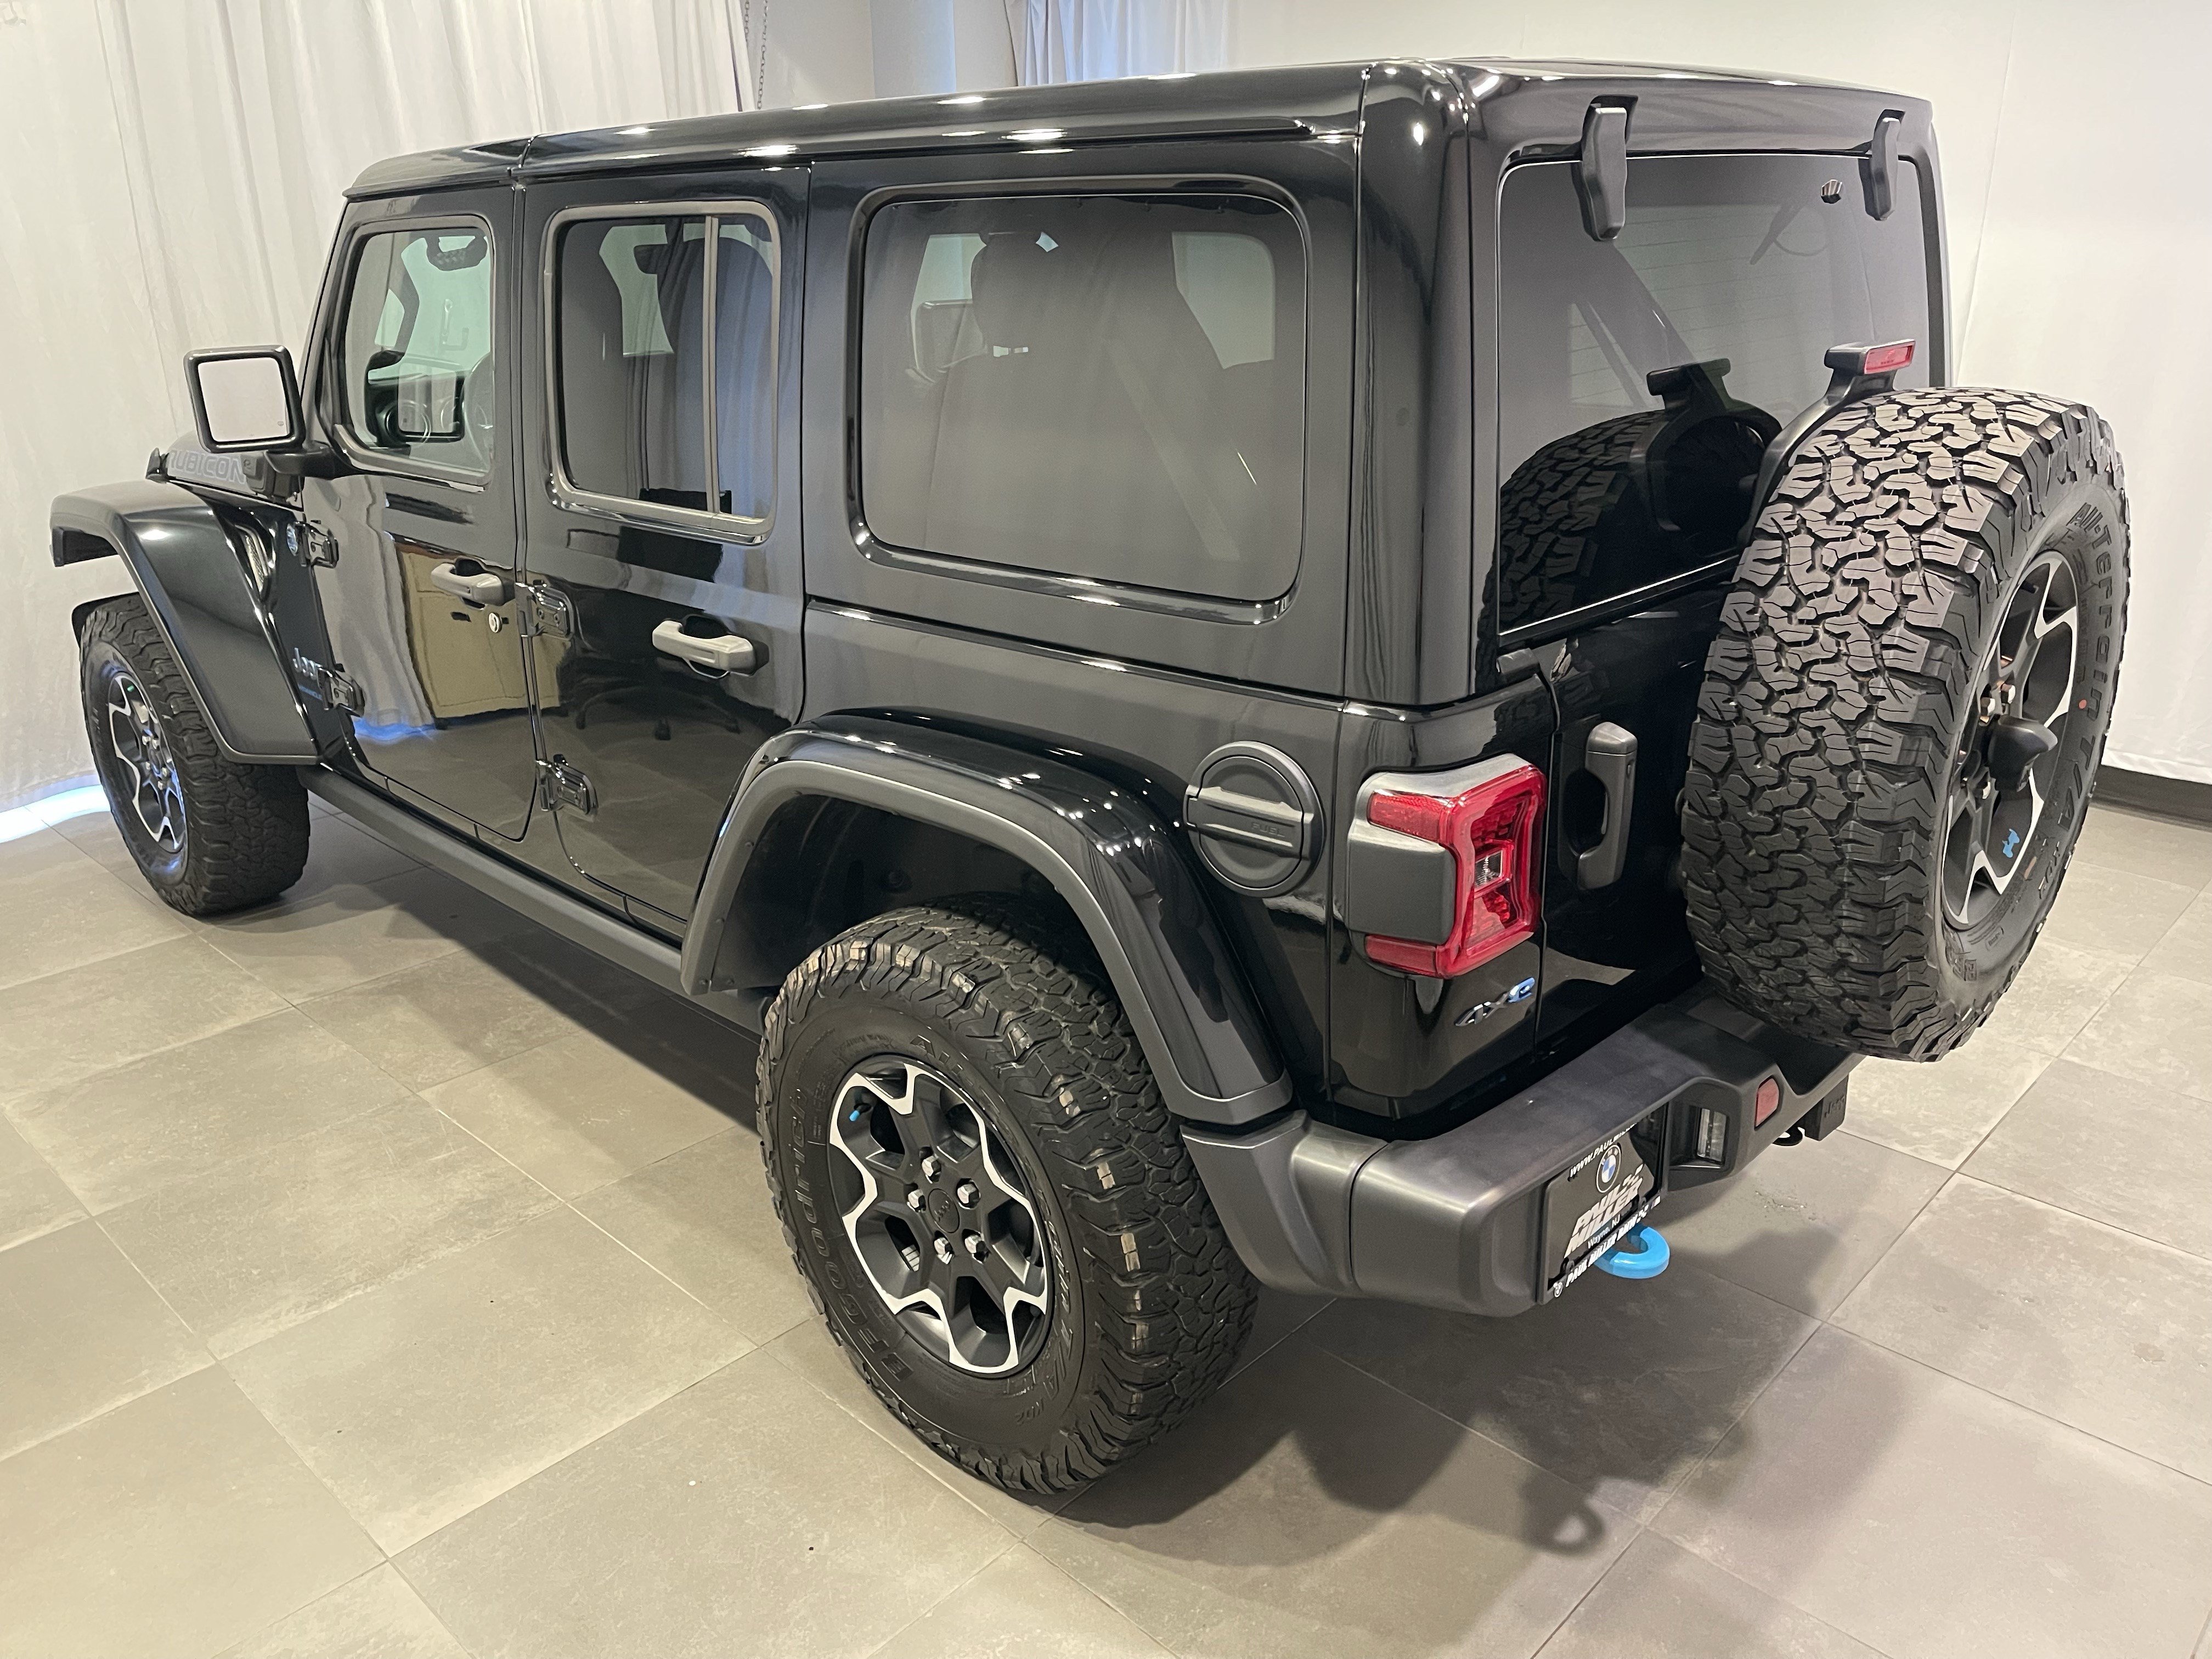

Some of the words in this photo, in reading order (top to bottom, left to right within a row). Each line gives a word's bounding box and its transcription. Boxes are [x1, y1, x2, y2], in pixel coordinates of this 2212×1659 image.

[1564, 1177, 1643, 1259] MILLER
[1572, 1184, 1628, 1237] PAUL
[1611, 1214, 1621, 1228] NJ
